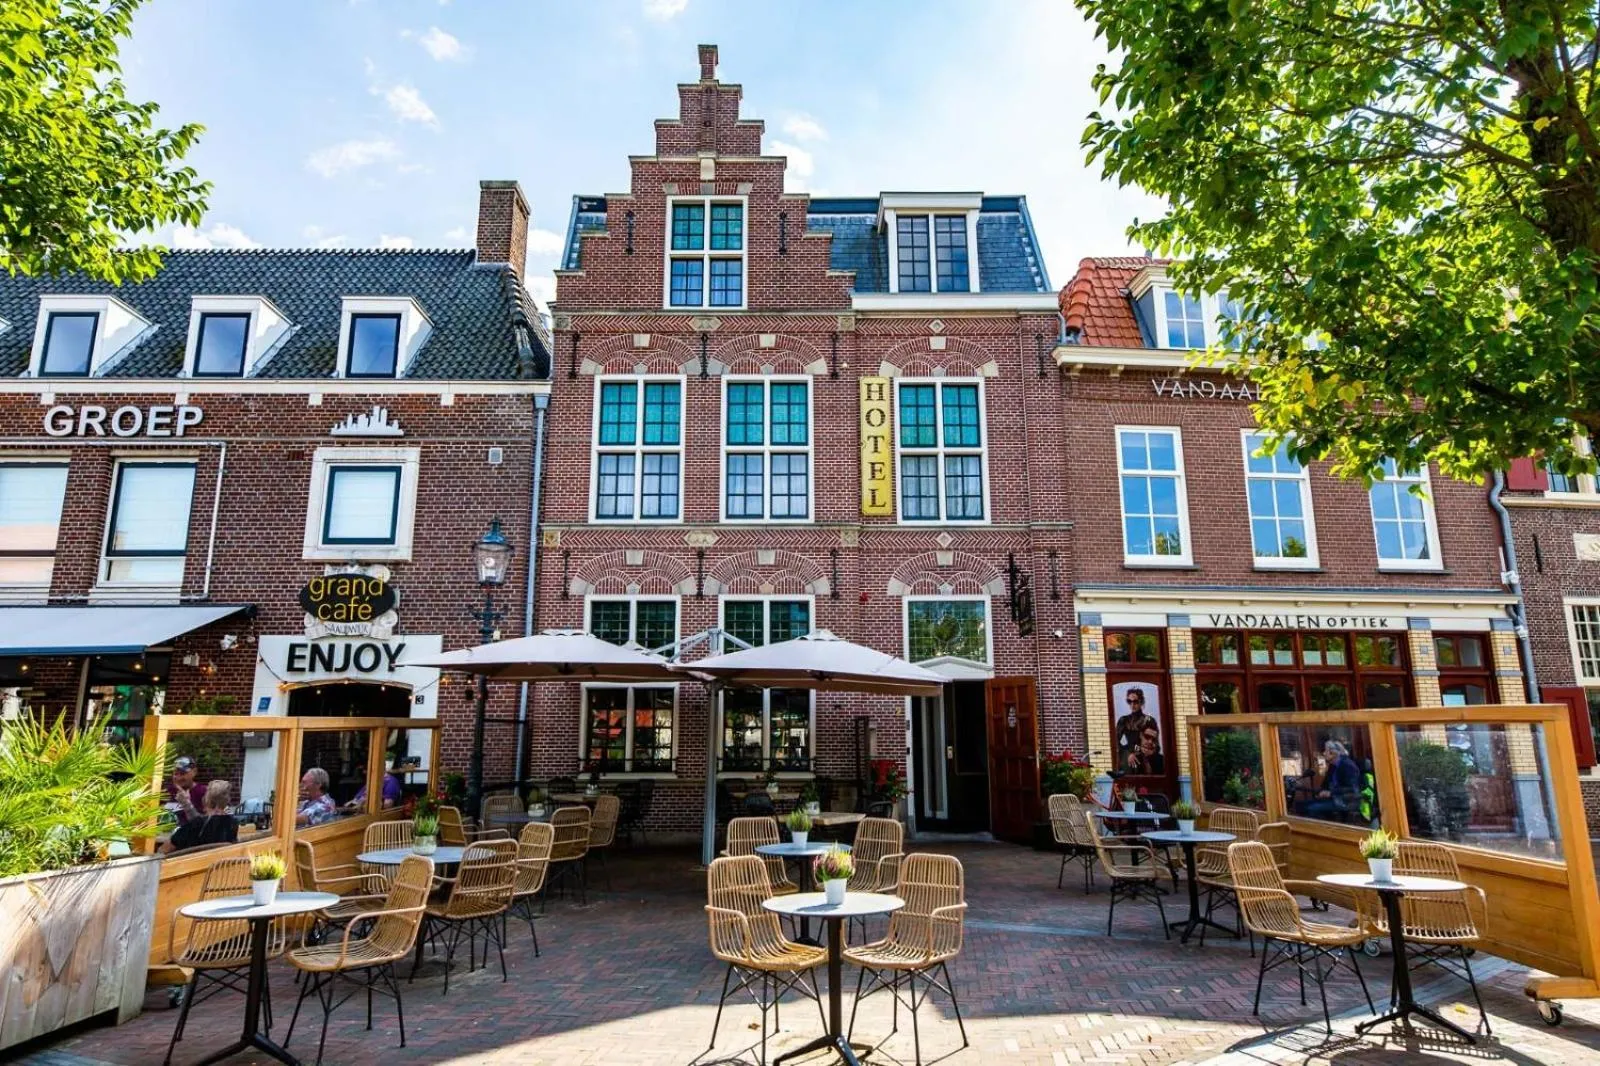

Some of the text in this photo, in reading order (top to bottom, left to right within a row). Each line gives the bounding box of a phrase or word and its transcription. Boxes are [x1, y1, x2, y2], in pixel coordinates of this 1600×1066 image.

[44, 405, 203, 437] GROEP
[864, 382, 887, 508] HOTEL
[309, 575, 384, 601] grand
[318, 596, 372, 620] café
[1209, 614, 1388, 629] VANDAALEN OPTIEK
[287, 643, 406, 672] ENJOY
